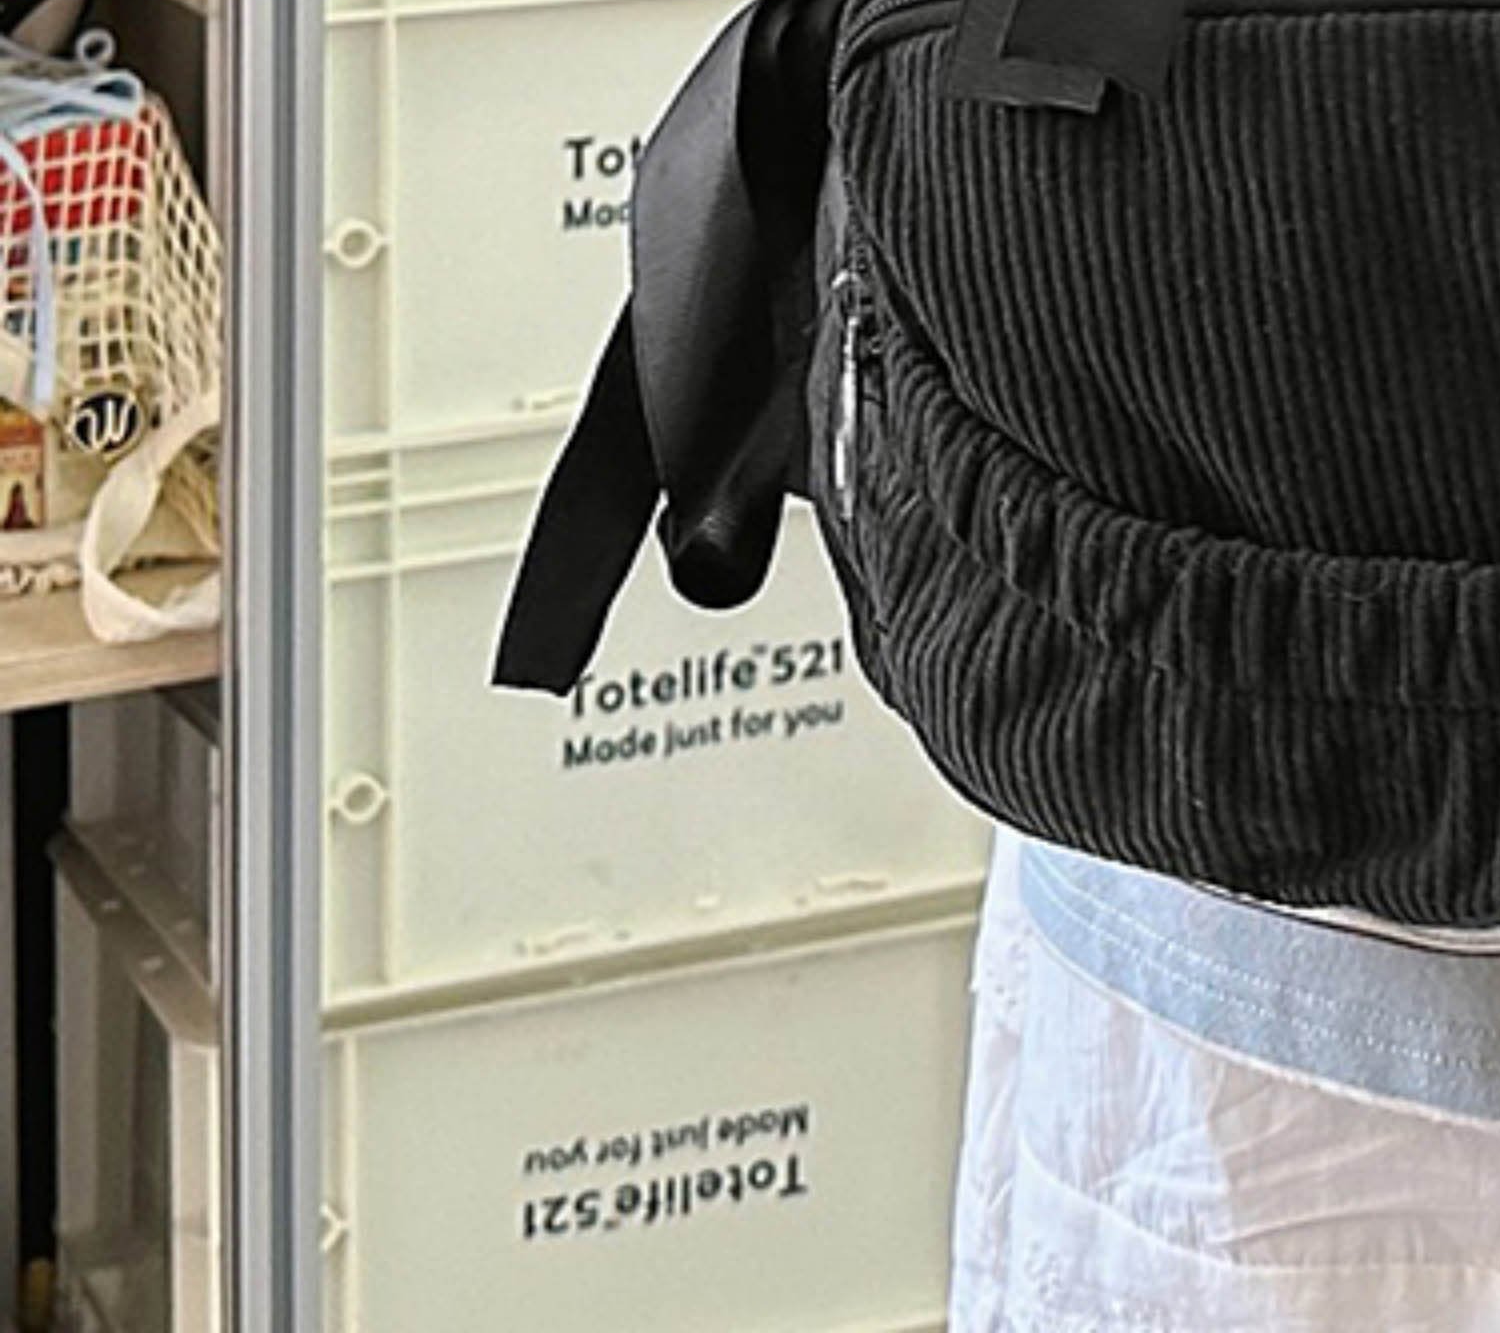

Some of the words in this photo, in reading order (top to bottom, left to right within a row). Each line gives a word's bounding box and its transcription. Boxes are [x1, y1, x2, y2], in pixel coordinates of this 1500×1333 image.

[563, 727, 657, 768] Made
[664, 716, 721, 758] just
[731, 707, 775, 738] for
[783, 700, 844, 738] you
[651, 1116, 709, 1157] just
[717, 1101, 809, 1146] Made
[523, 1136, 589, 1175] you
[596, 1132, 641, 1167] for
